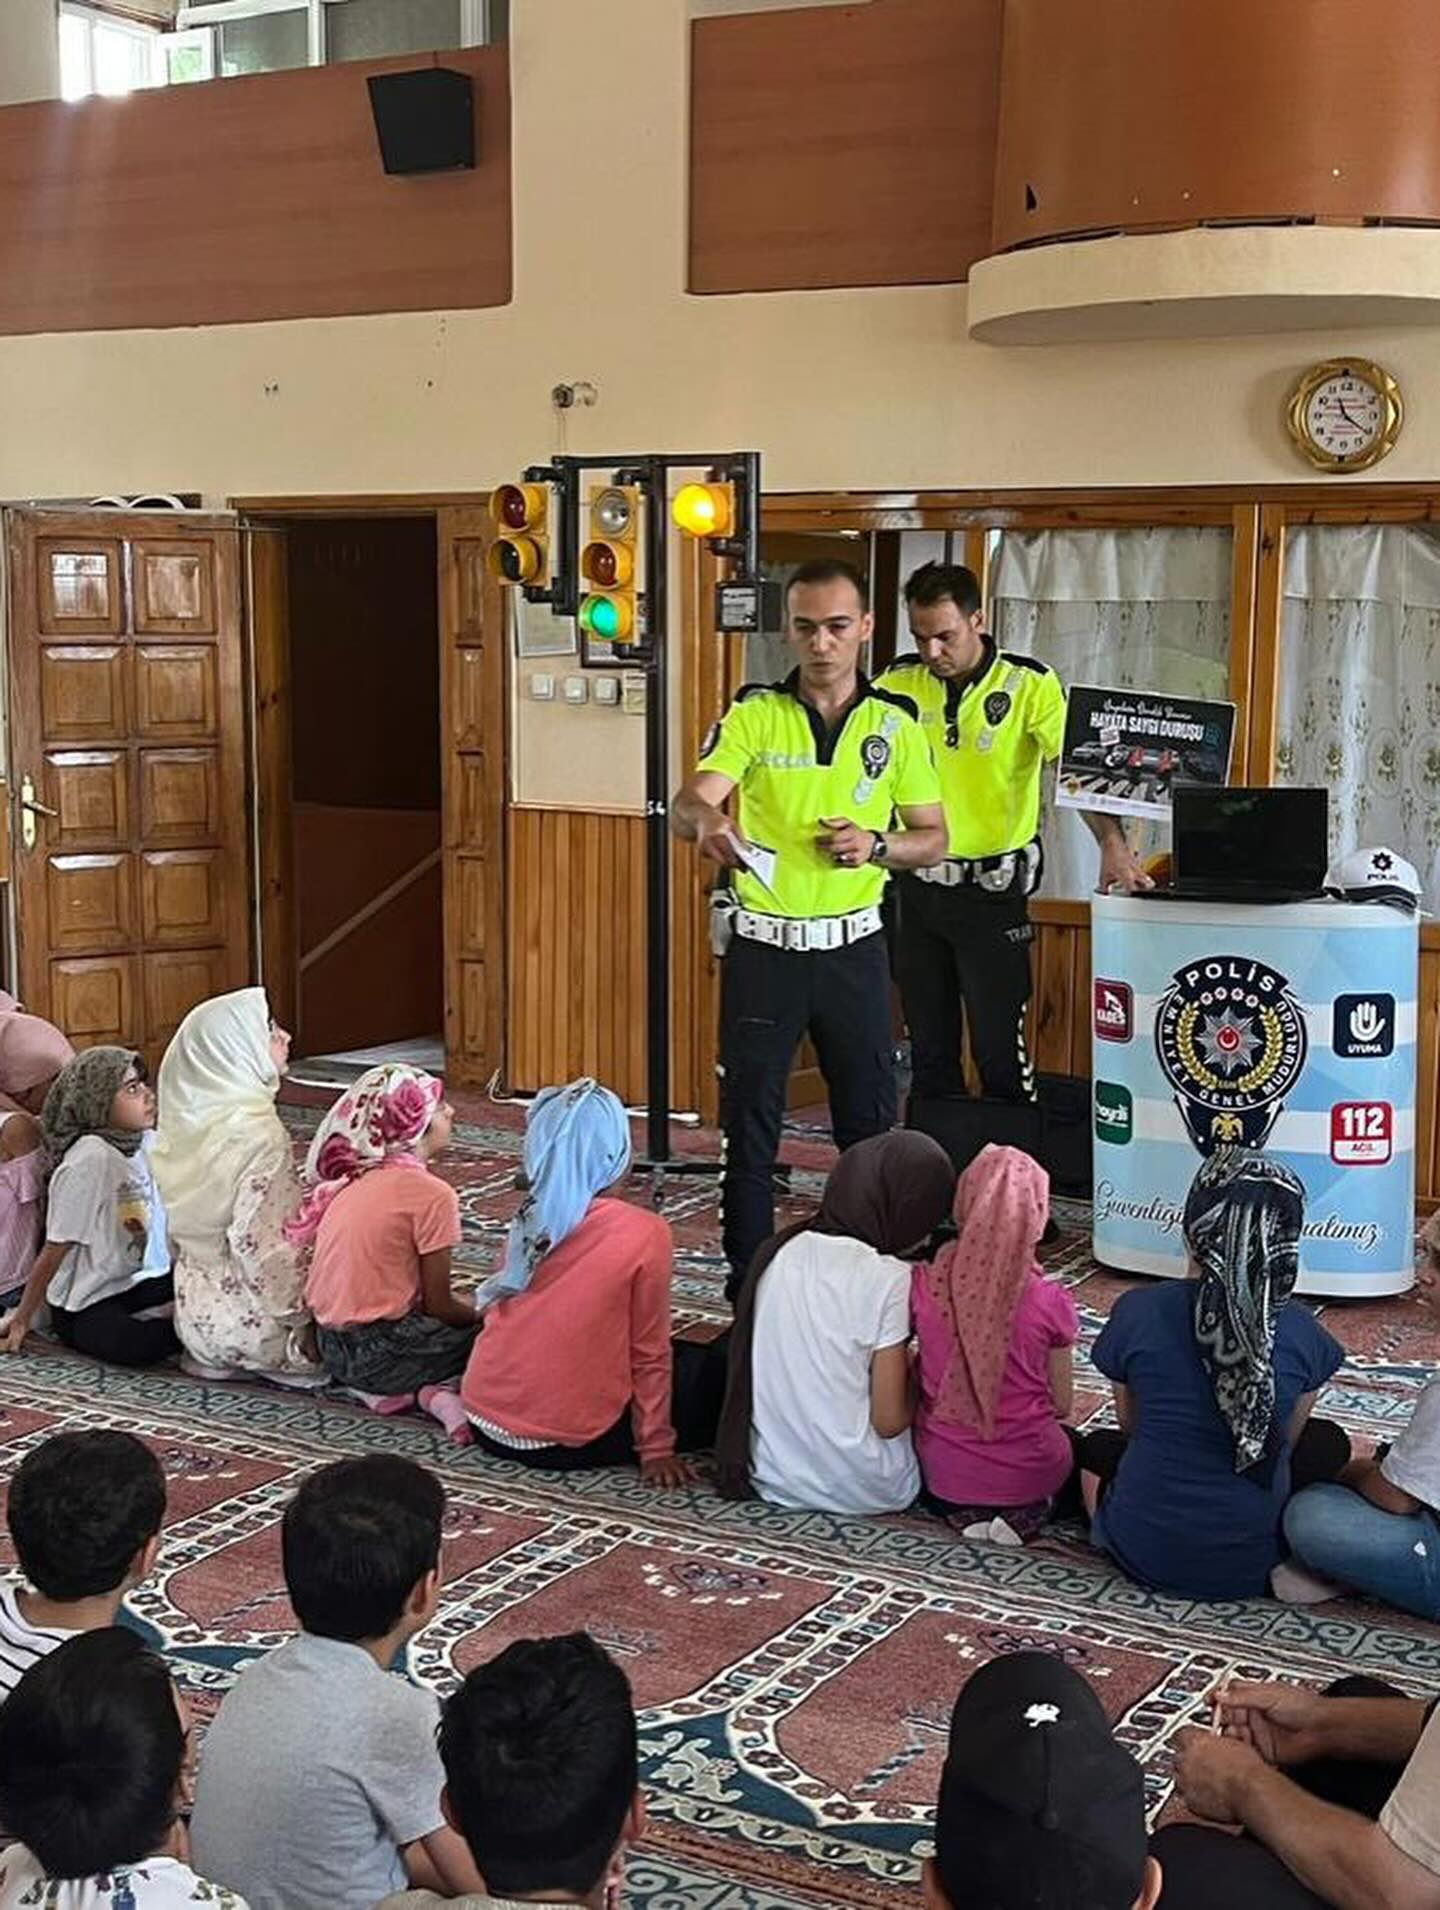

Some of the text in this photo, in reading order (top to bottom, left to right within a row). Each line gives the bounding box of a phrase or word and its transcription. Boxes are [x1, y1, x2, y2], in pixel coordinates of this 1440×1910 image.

[1129, 716, 1159, 736] SAYGI
[1185, 962, 1276, 992] POLİS
[1347, 1043, 1382, 1054] UYUMA
[1341, 1106, 1385, 1137] 112
